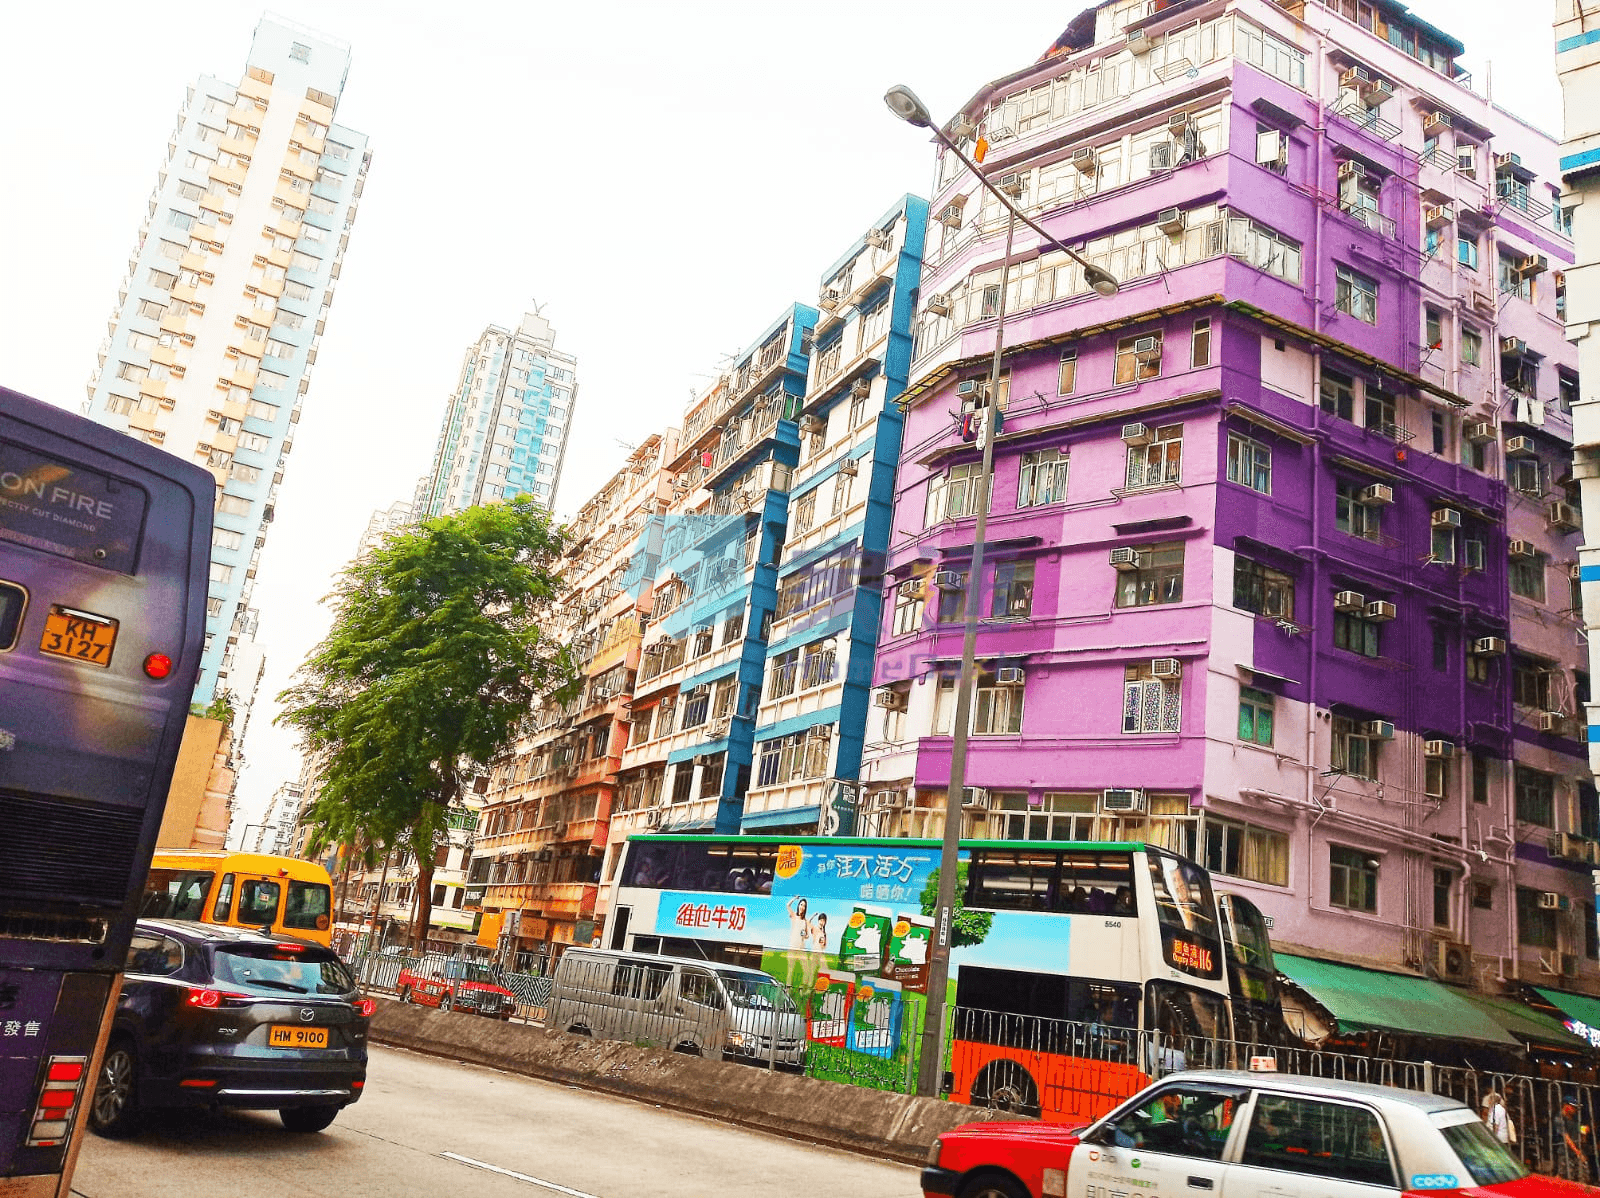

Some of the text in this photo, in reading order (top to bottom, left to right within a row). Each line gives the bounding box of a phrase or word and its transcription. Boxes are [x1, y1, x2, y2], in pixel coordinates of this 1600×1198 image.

[1, 471, 114, 520] ON FIRE
[52, 513, 96, 532] DIAMOND
[65, 619, 97, 642] KH
[47, 633, 106, 660] 3127
[676, 903, 746, 931] 維他牛奶
[1199, 948, 1212, 971] 116
[0, 1020, 42, 1037] 發售
[274, 1030, 325, 1044] HM 9100
